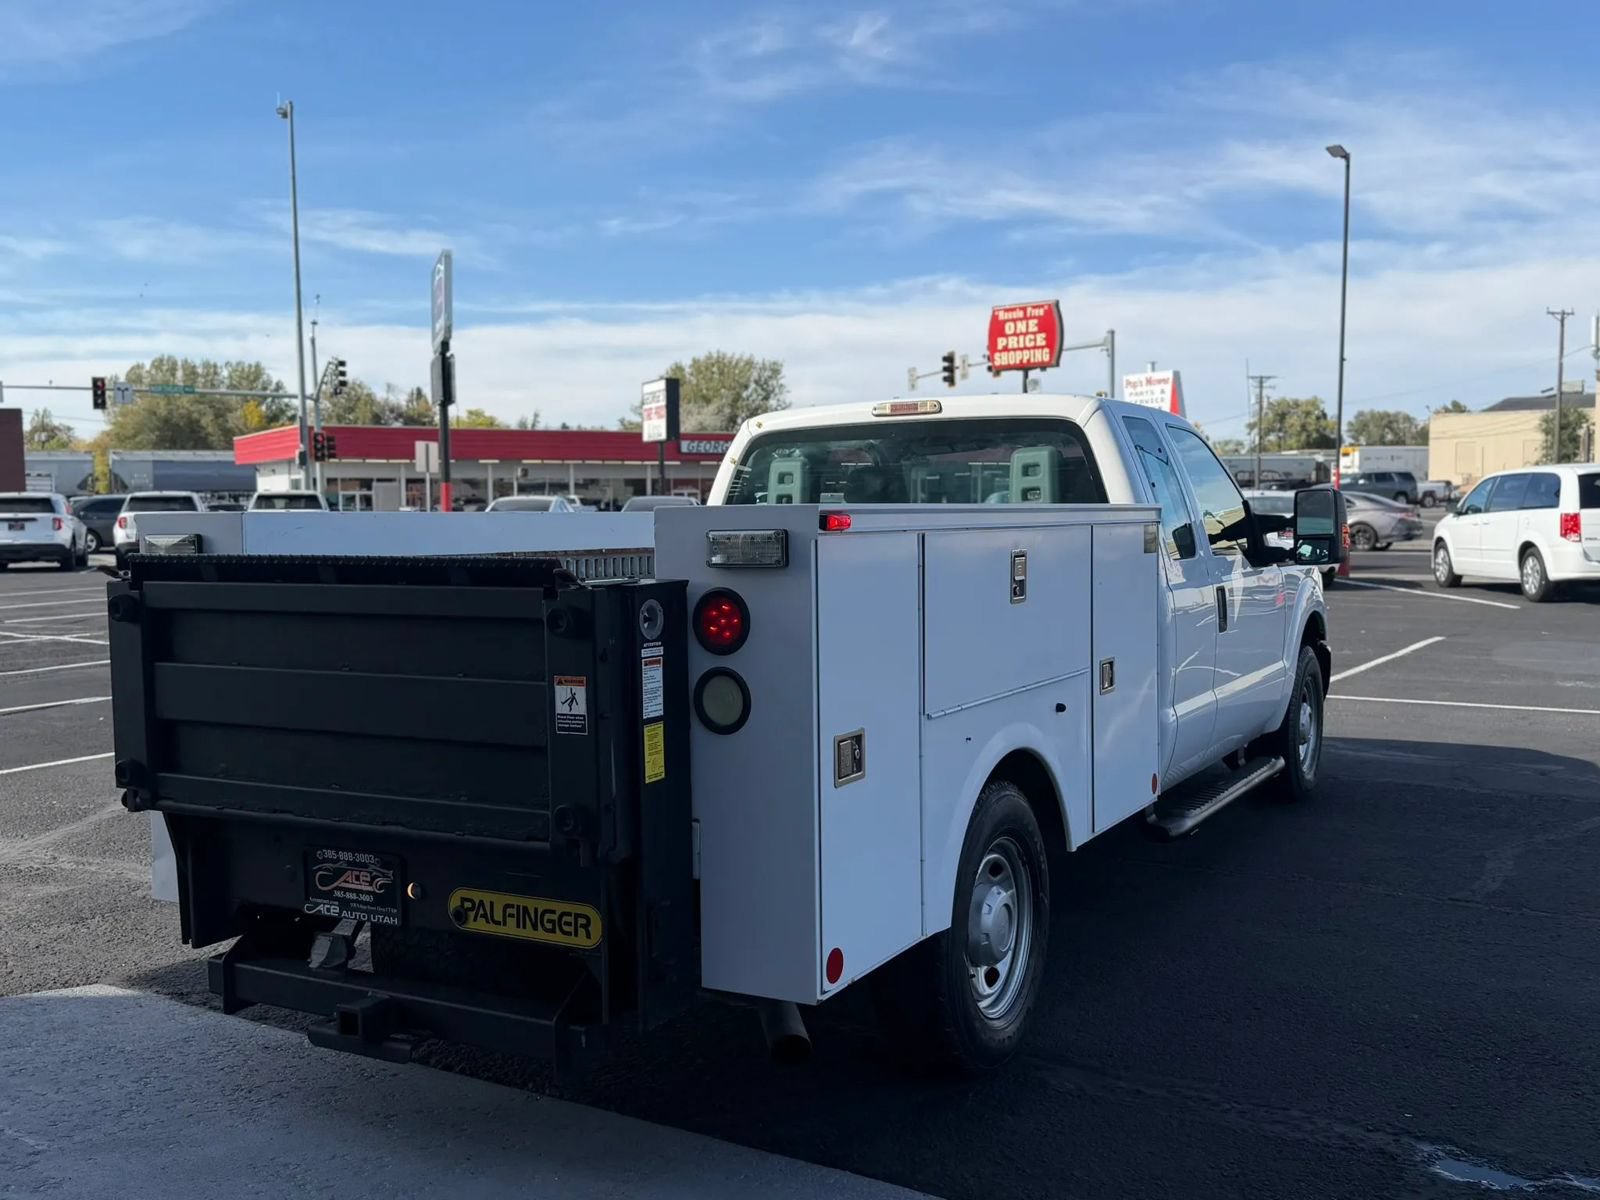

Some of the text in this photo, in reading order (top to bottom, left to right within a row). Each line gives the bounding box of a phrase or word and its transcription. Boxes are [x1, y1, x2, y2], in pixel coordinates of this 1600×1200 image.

[1004, 319, 1039, 335] ONE
[997, 333, 1047, 350] PRICE
[994, 348, 1050, 366] SHOPPING
[341, 910, 368, 921] AUTO
[370, 914, 398, 926] UTAH
[459, 896, 592, 940] PALFINGER
